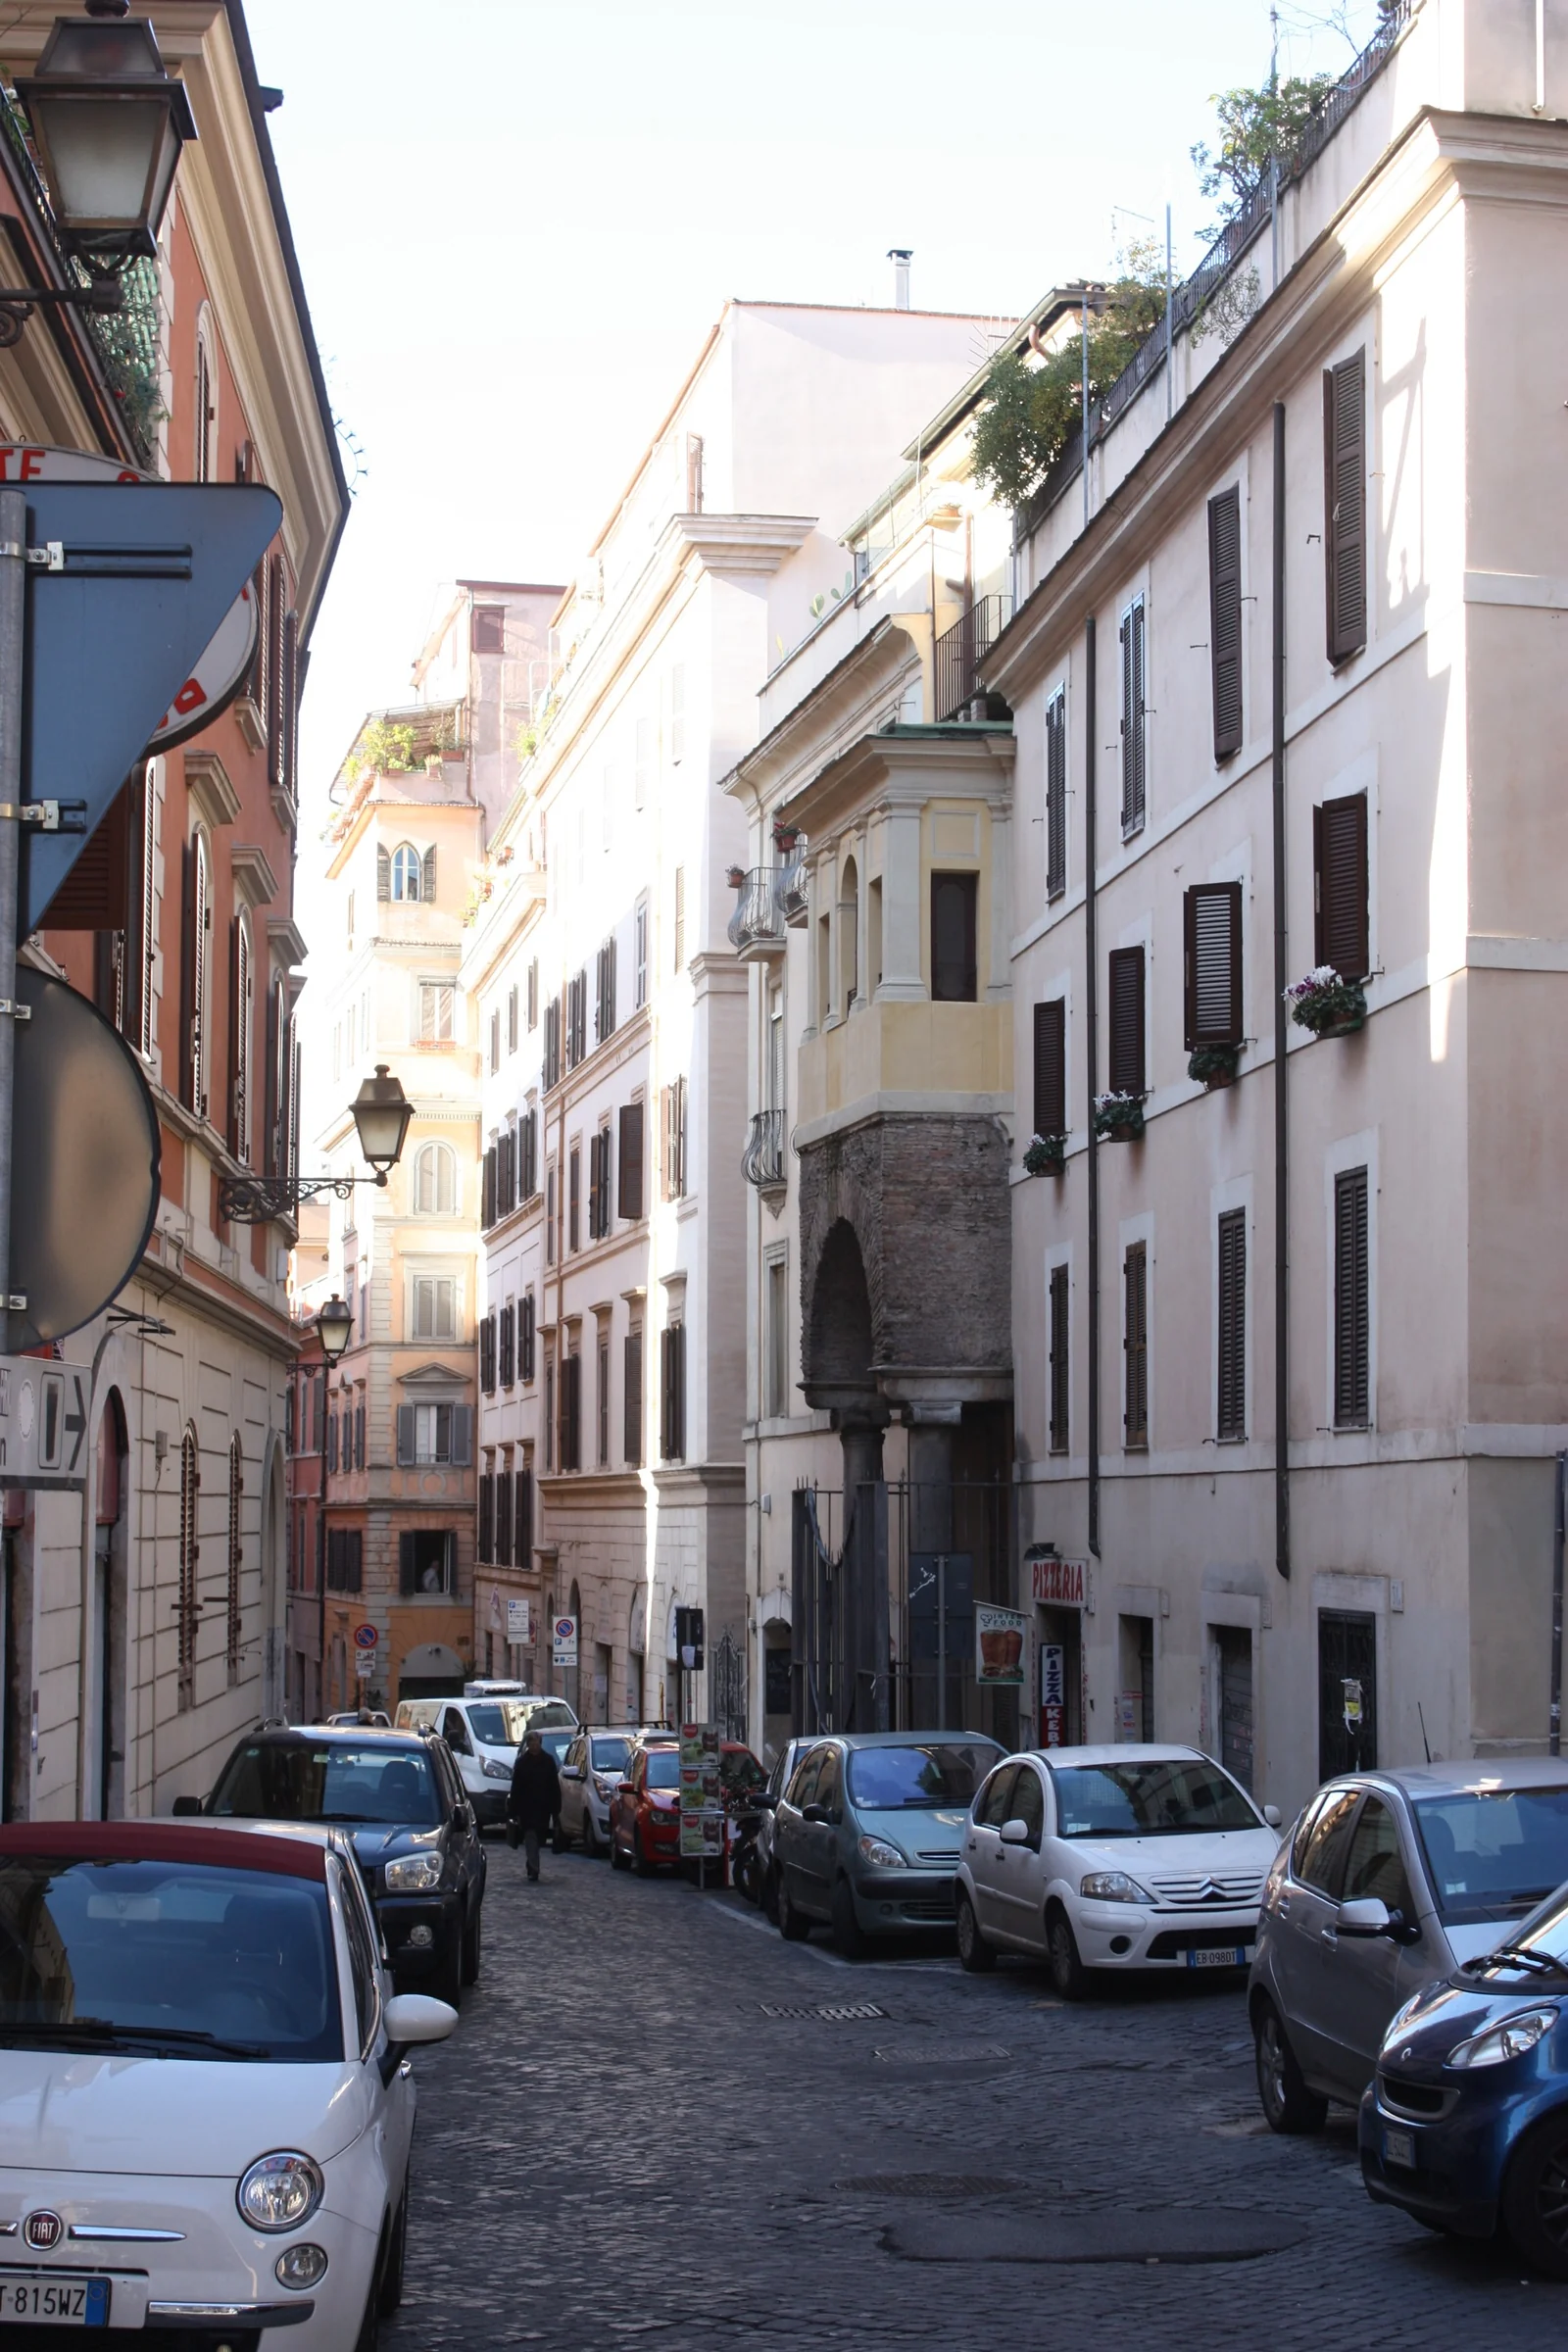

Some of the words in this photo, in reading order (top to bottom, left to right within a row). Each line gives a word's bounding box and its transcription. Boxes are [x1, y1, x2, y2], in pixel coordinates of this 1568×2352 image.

[1033, 1562, 1084, 1601] PIZZERIA
[1045, 1647, 1062, 1704] PIZZA
[32, 2222, 54, 2239] FIAT
